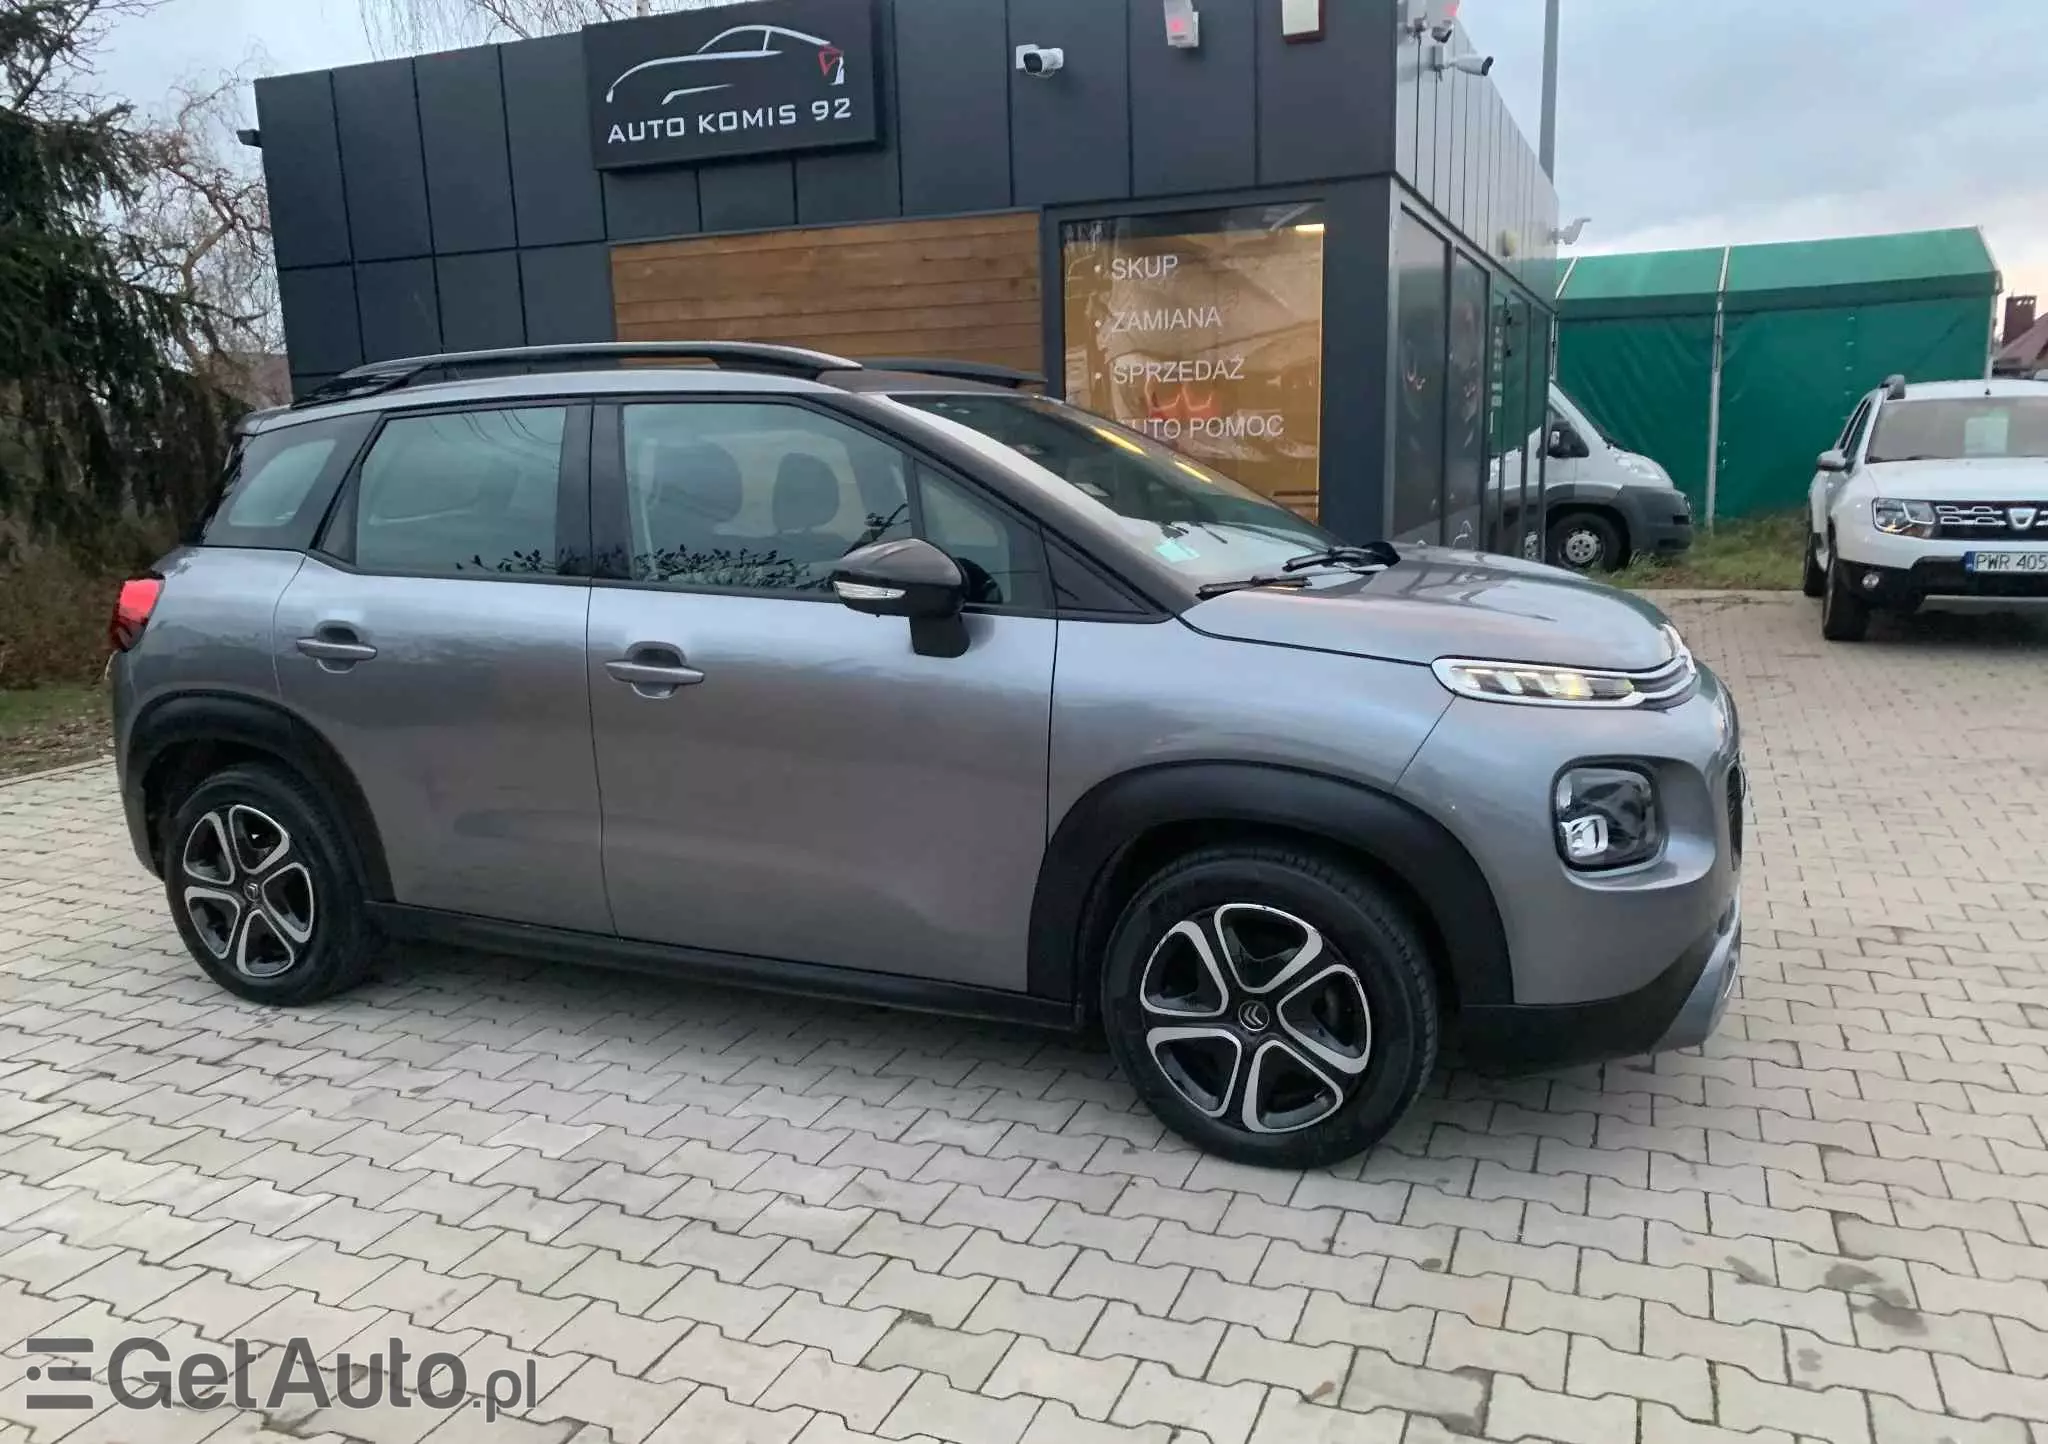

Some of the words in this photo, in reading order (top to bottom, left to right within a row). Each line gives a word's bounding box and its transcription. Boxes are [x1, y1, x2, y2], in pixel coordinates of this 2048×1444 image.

[607, 116, 685, 144] AUTO
[698, 104, 797, 134] KOMIS
[811, 97, 852, 121] 92
[1111, 255, 1178, 281] SKUP
[1111, 306, 1222, 333] ZAMIANA
[1112, 354, 1245, 385] SPRZEDAŻ
[1117, 417, 1181, 439] UTO
[1189, 415, 1284, 440] POMOC
[1976, 554, 2010, 569] PWR
